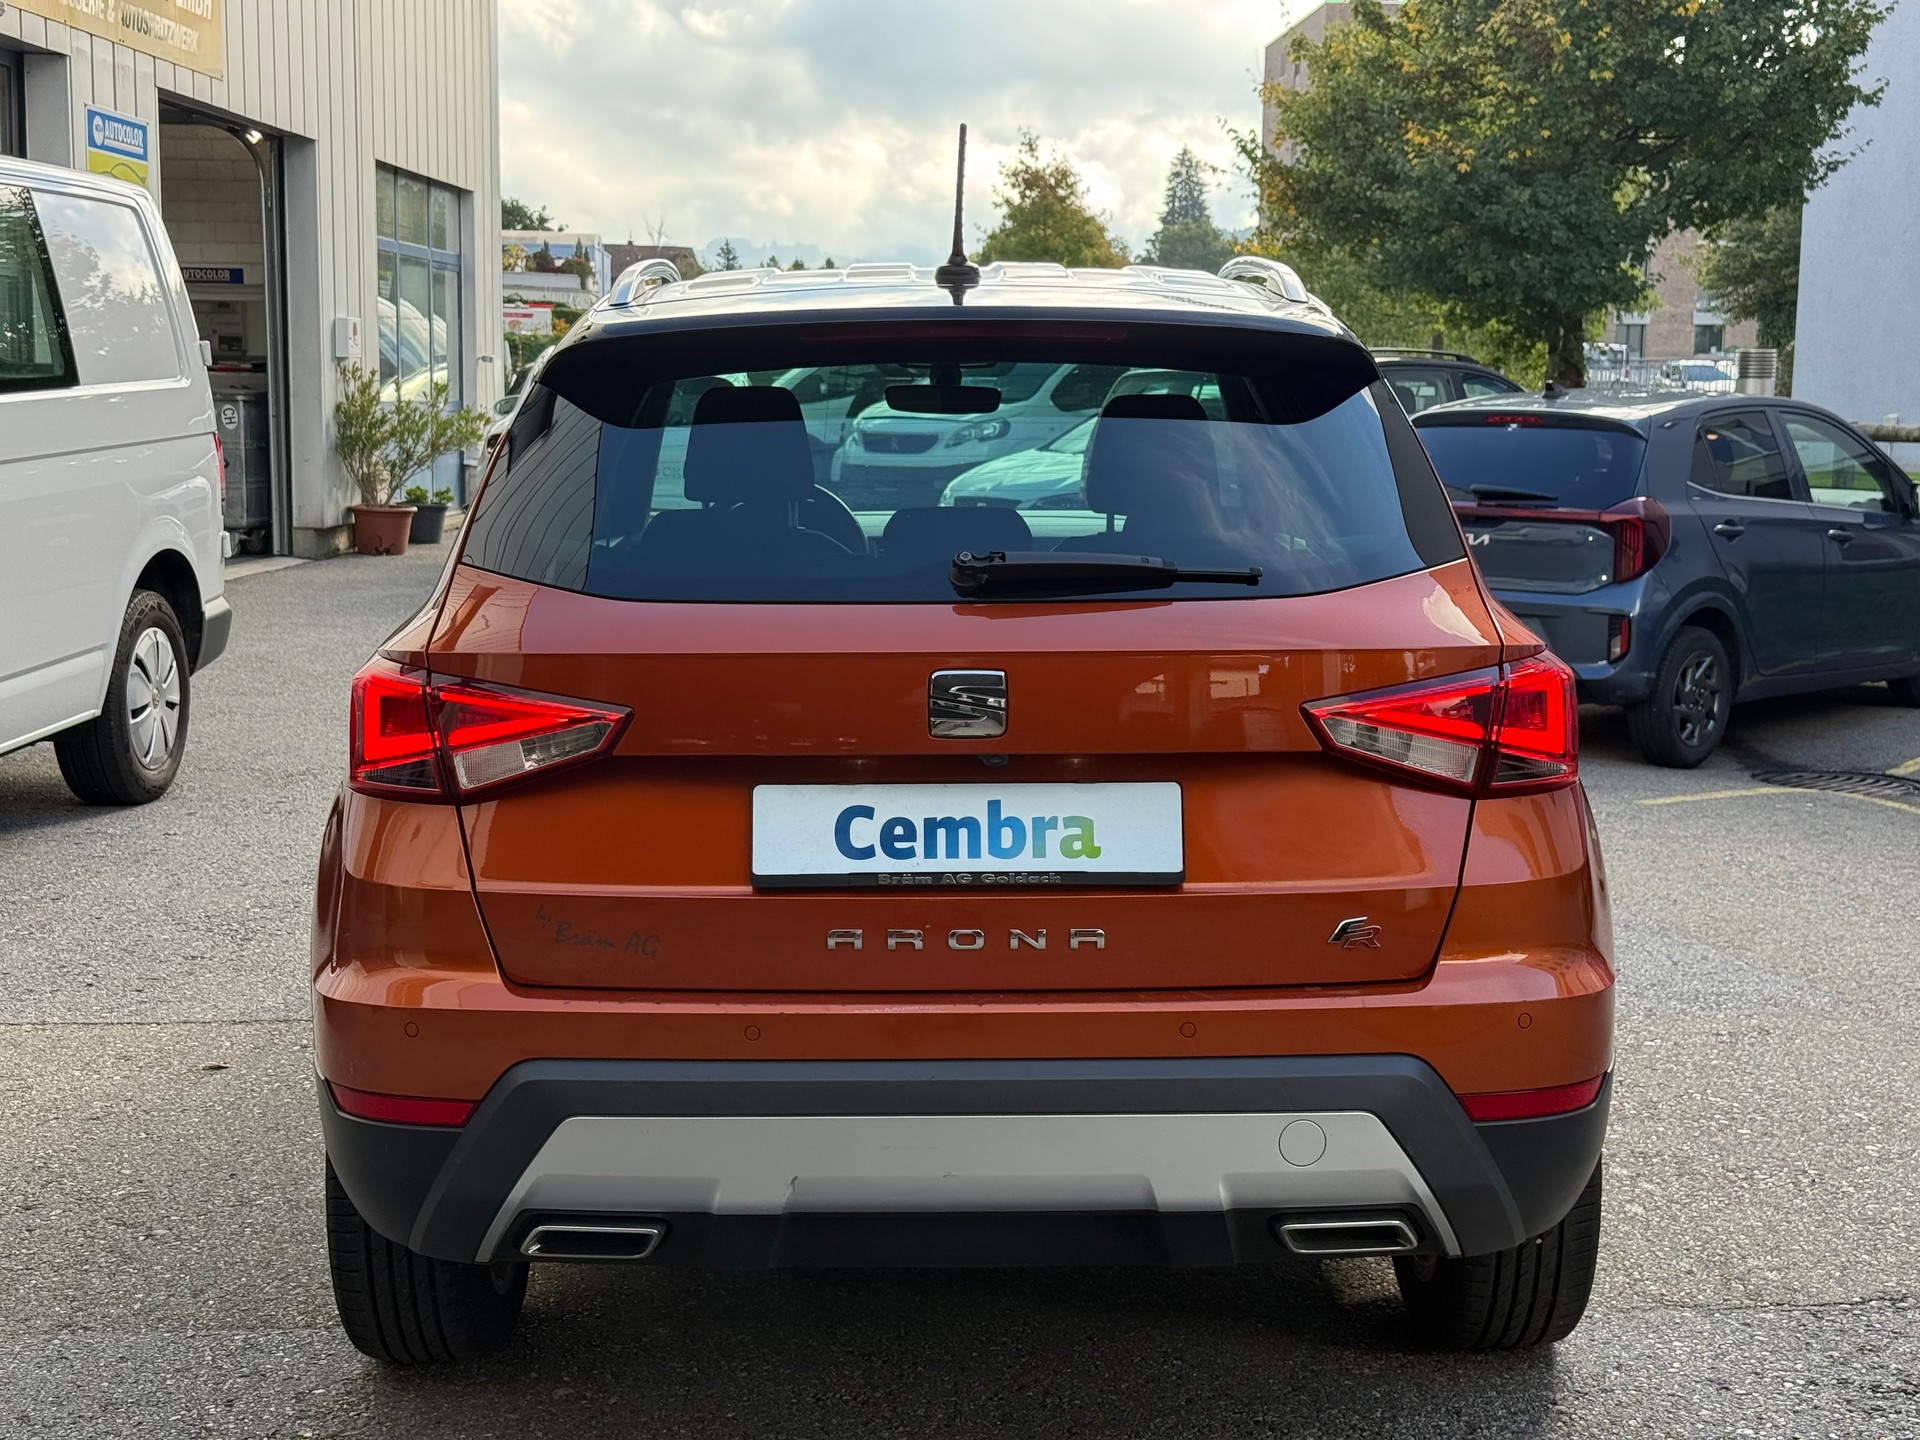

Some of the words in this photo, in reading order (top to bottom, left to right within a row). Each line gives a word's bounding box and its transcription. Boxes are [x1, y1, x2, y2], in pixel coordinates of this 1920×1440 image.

[118, 2, 199, 55] AUTOSPRITZWERK
[104, 119, 144, 148] AUTOCOLOR
[182, 268, 231, 279] UTOCOLOR
[223, 407, 237, 425] CH
[834, 799, 1102, 862] Cembra
[877, 873, 933, 885] Bräm
[941, 873, 973, 885] AG
[980, 873, 1062, 885] Goldach
[535, 903, 552, 929] by
[555, 919, 616, 948] Bräm
[623, 930, 662, 960] AG
[826, 927, 1107, 951] ARONA
[1327, 914, 1382, 949] FR
